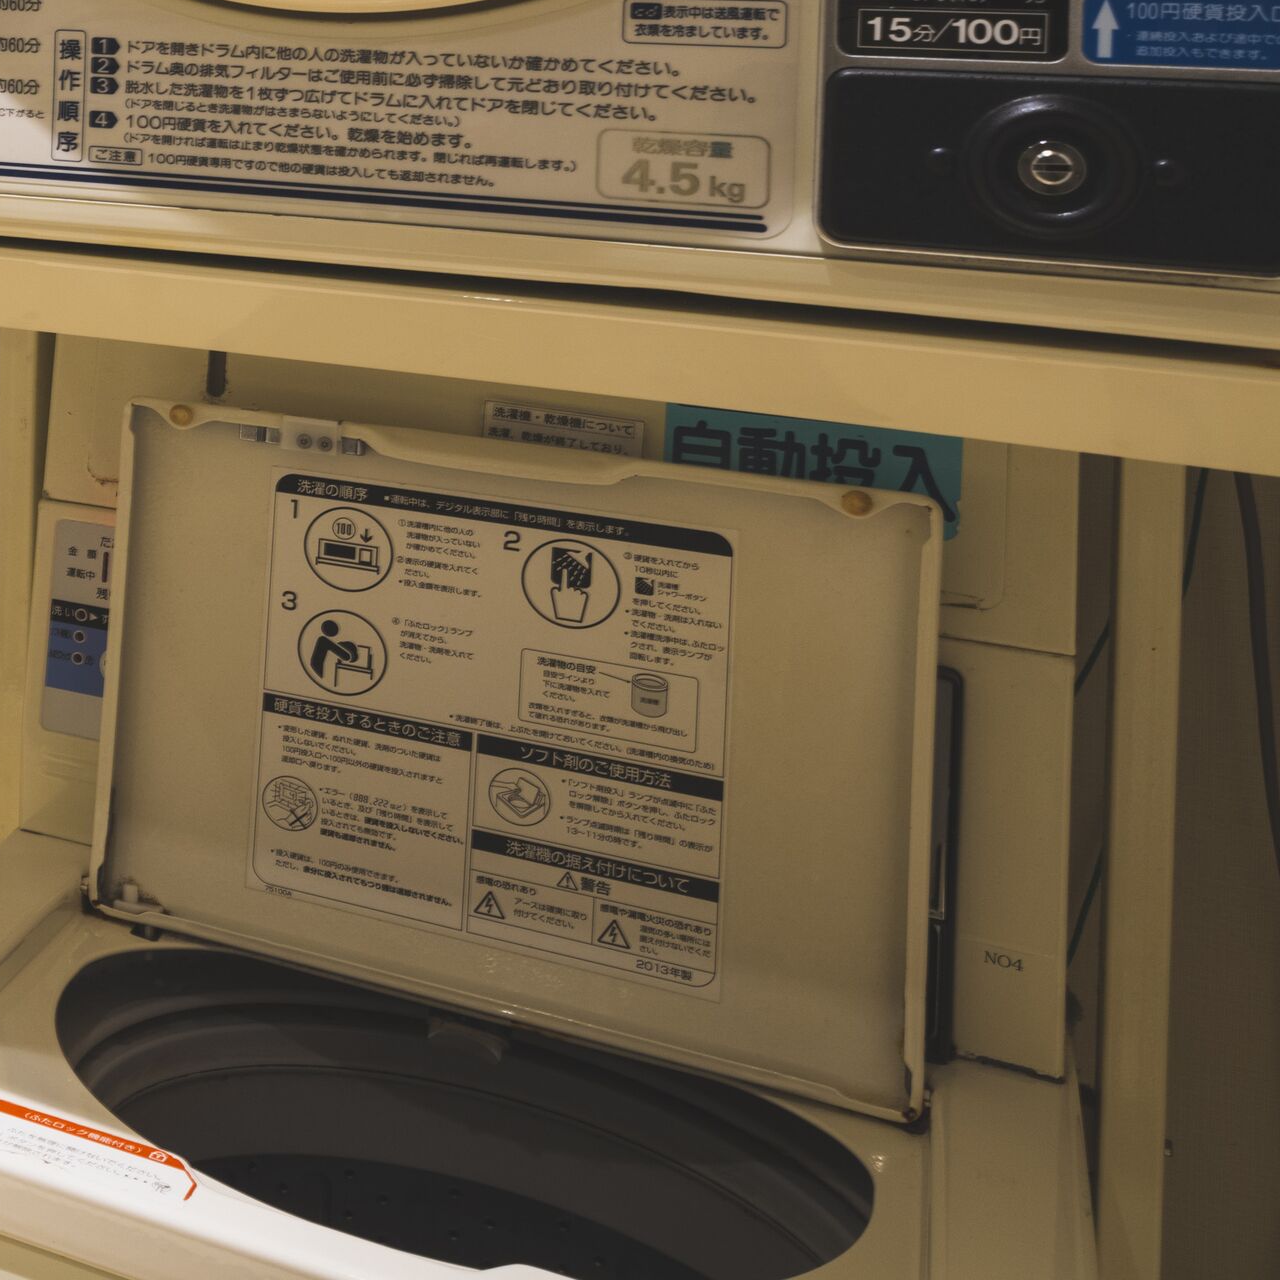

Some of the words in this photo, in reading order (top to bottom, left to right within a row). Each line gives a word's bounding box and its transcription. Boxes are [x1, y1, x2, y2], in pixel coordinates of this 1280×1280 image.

[867, 16, 1042, 47] 15分/100円
[96, 150, 136, 163] ご注意
[621, 158, 700, 196] 4.5
[709, 177, 746, 203] kg
[672, 421, 958, 522] 自動投入
[296, 479, 368, 502] 洗濯の順序
[290, 499, 299, 519] 1
[503, 530, 521, 551] 2
[281, 590, 298, 611] 3
[274, 698, 460, 747] 硬貨を投入するときのご注意
[520, 746, 671, 789] ソフト剤のご使用方法
[506, 840, 689, 893] 洗濯機の据え付けについて
[580, 877, 611, 896] 警告
[636, 959, 692, 981] 2013年製
[984, 950, 1024, 972] NO4
